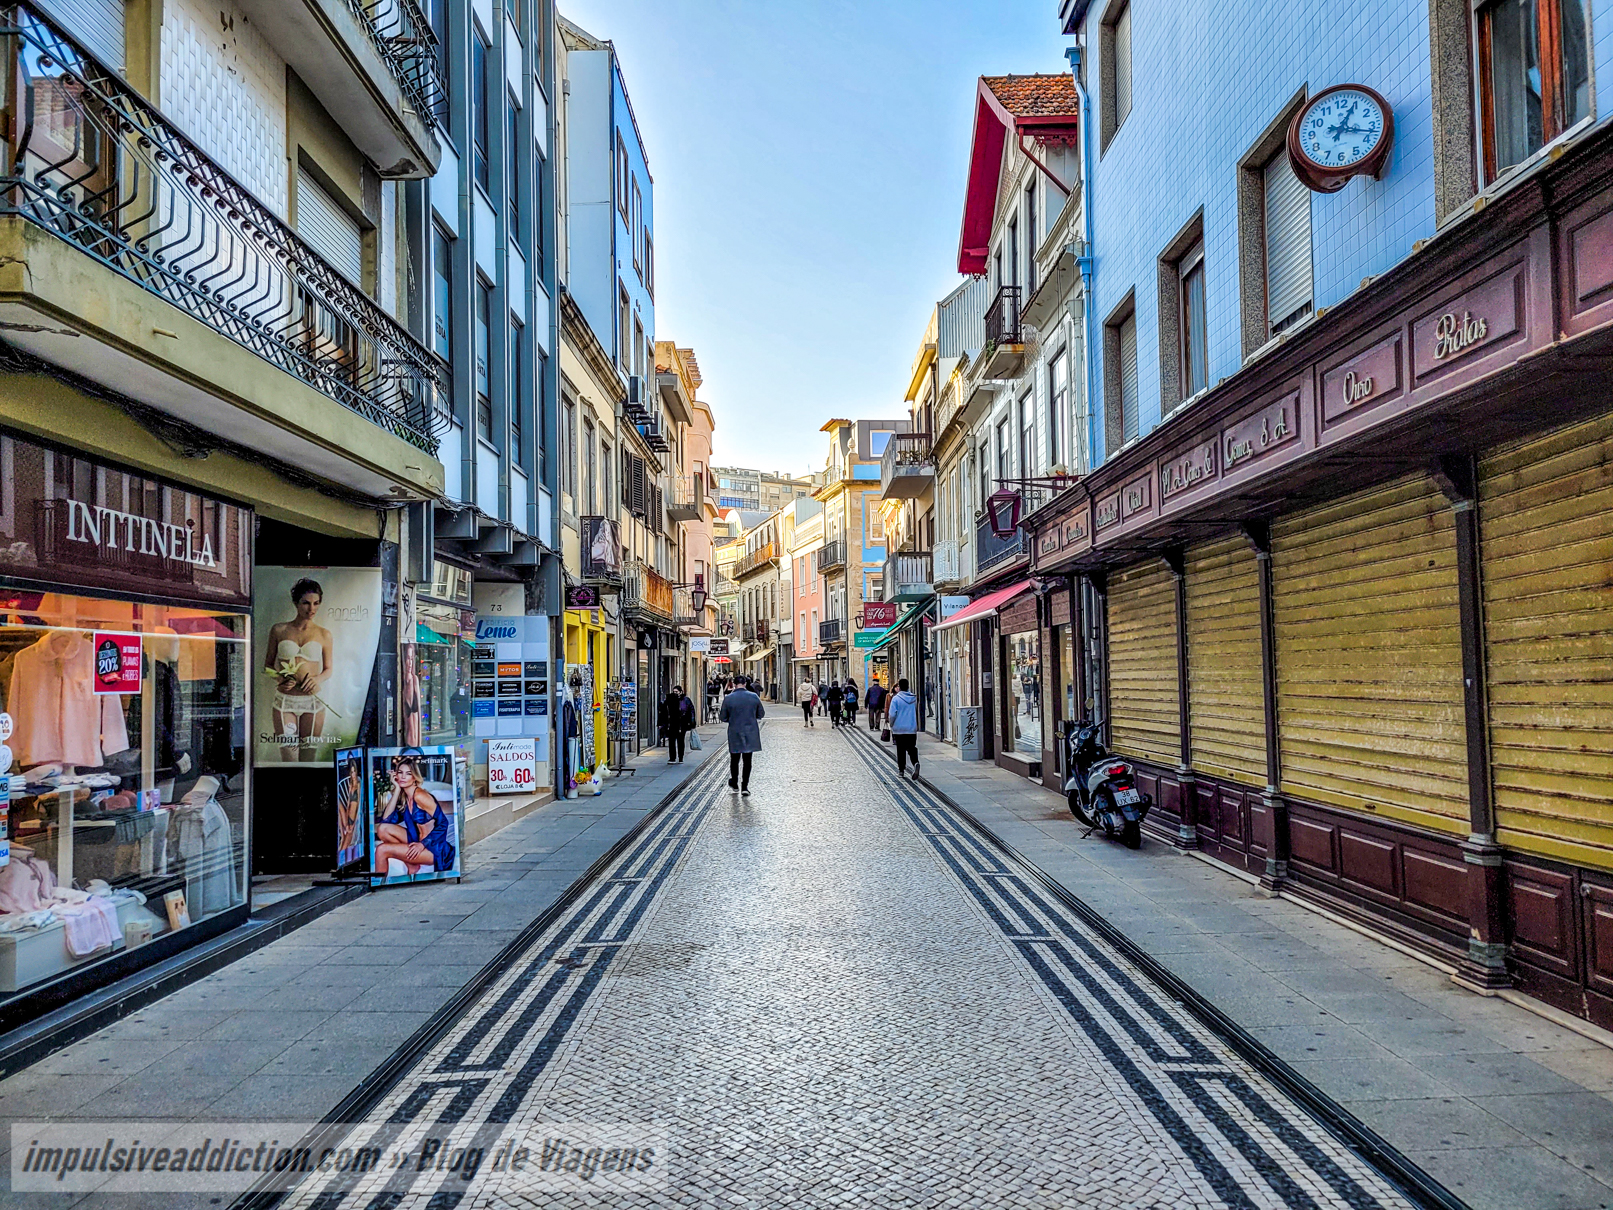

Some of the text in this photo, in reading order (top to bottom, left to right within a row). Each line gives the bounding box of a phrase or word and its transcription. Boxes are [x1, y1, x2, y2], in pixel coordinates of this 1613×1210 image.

[1334, 99, 1348, 110] 12
[1320, 106, 1331, 116] 11
[1362, 108, 1371, 118] 2
[1311, 118, 1324, 128] 10
[1368, 121, 1376, 130] 3
[1308, 130, 1316, 140] 9
[1362, 135, 1371, 144] 4
[1312, 142, 1320, 152] 8
[1352, 146, 1360, 156] 5
[1324, 150, 1331, 160] 7
[1337, 152, 1345, 162] 6
[1434, 311, 1488, 359] Pratas
[1343, 371, 1373, 405] Ouro
[66, 499, 216, 568] INTTINELA
[490, 604, 502, 612] 73
[873, 607, 885, 620] 76
[475, 619, 517, 639] Leme
[98, 656, 119, 675] 20%
[305, 733, 342, 744] novias
[490, 752, 534, 762] SALDOS
[490, 769, 508, 782] 30%
[514, 768, 535, 784] 60%
[1121, 790, 1131, 798] 38
[1116, 798, 1128, 806] UX
